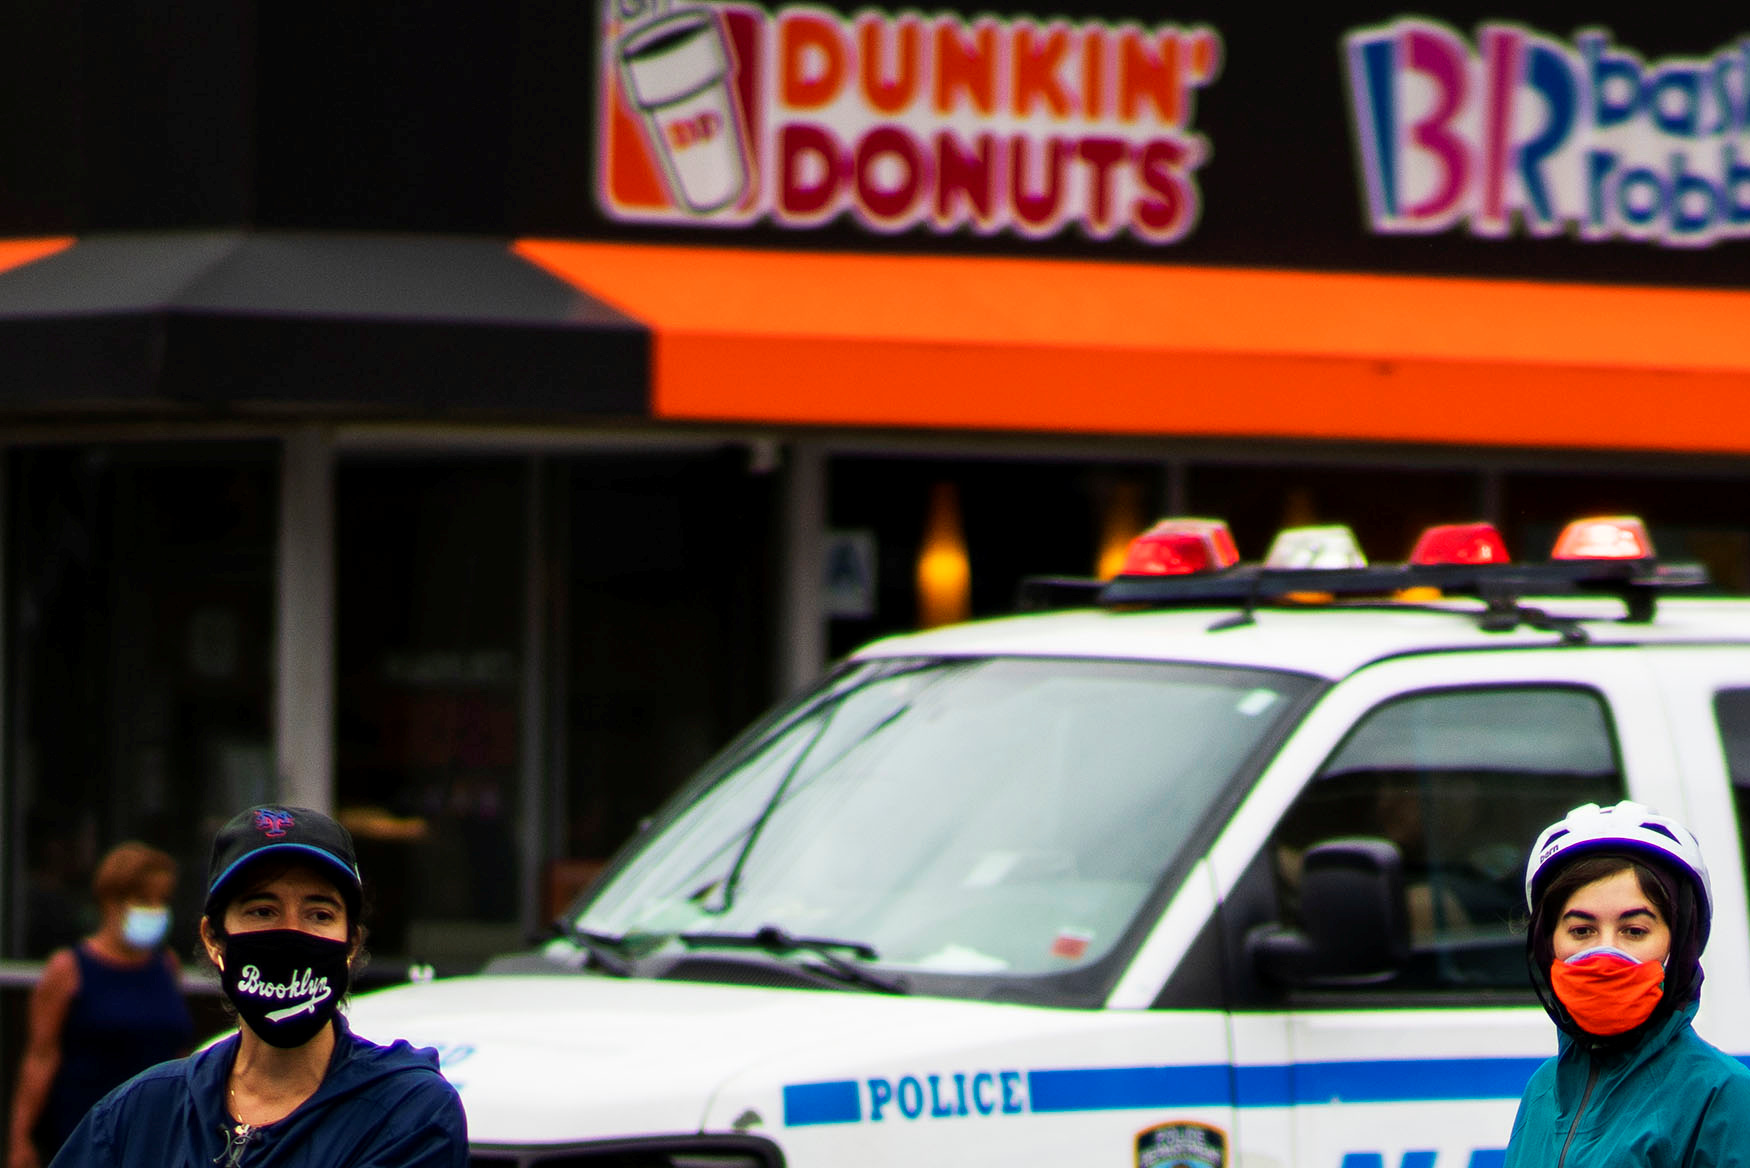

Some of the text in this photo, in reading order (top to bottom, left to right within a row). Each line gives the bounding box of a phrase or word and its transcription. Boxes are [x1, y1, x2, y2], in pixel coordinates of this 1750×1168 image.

[775, 14, 1214, 124] DUNKIN'
[775, 124, 1192, 230] DONUTS
[1356, 28, 1582, 224] BR
[237, 964, 332, 1020] Brooklyn
[867, 1071, 1027, 1121] POLICE
